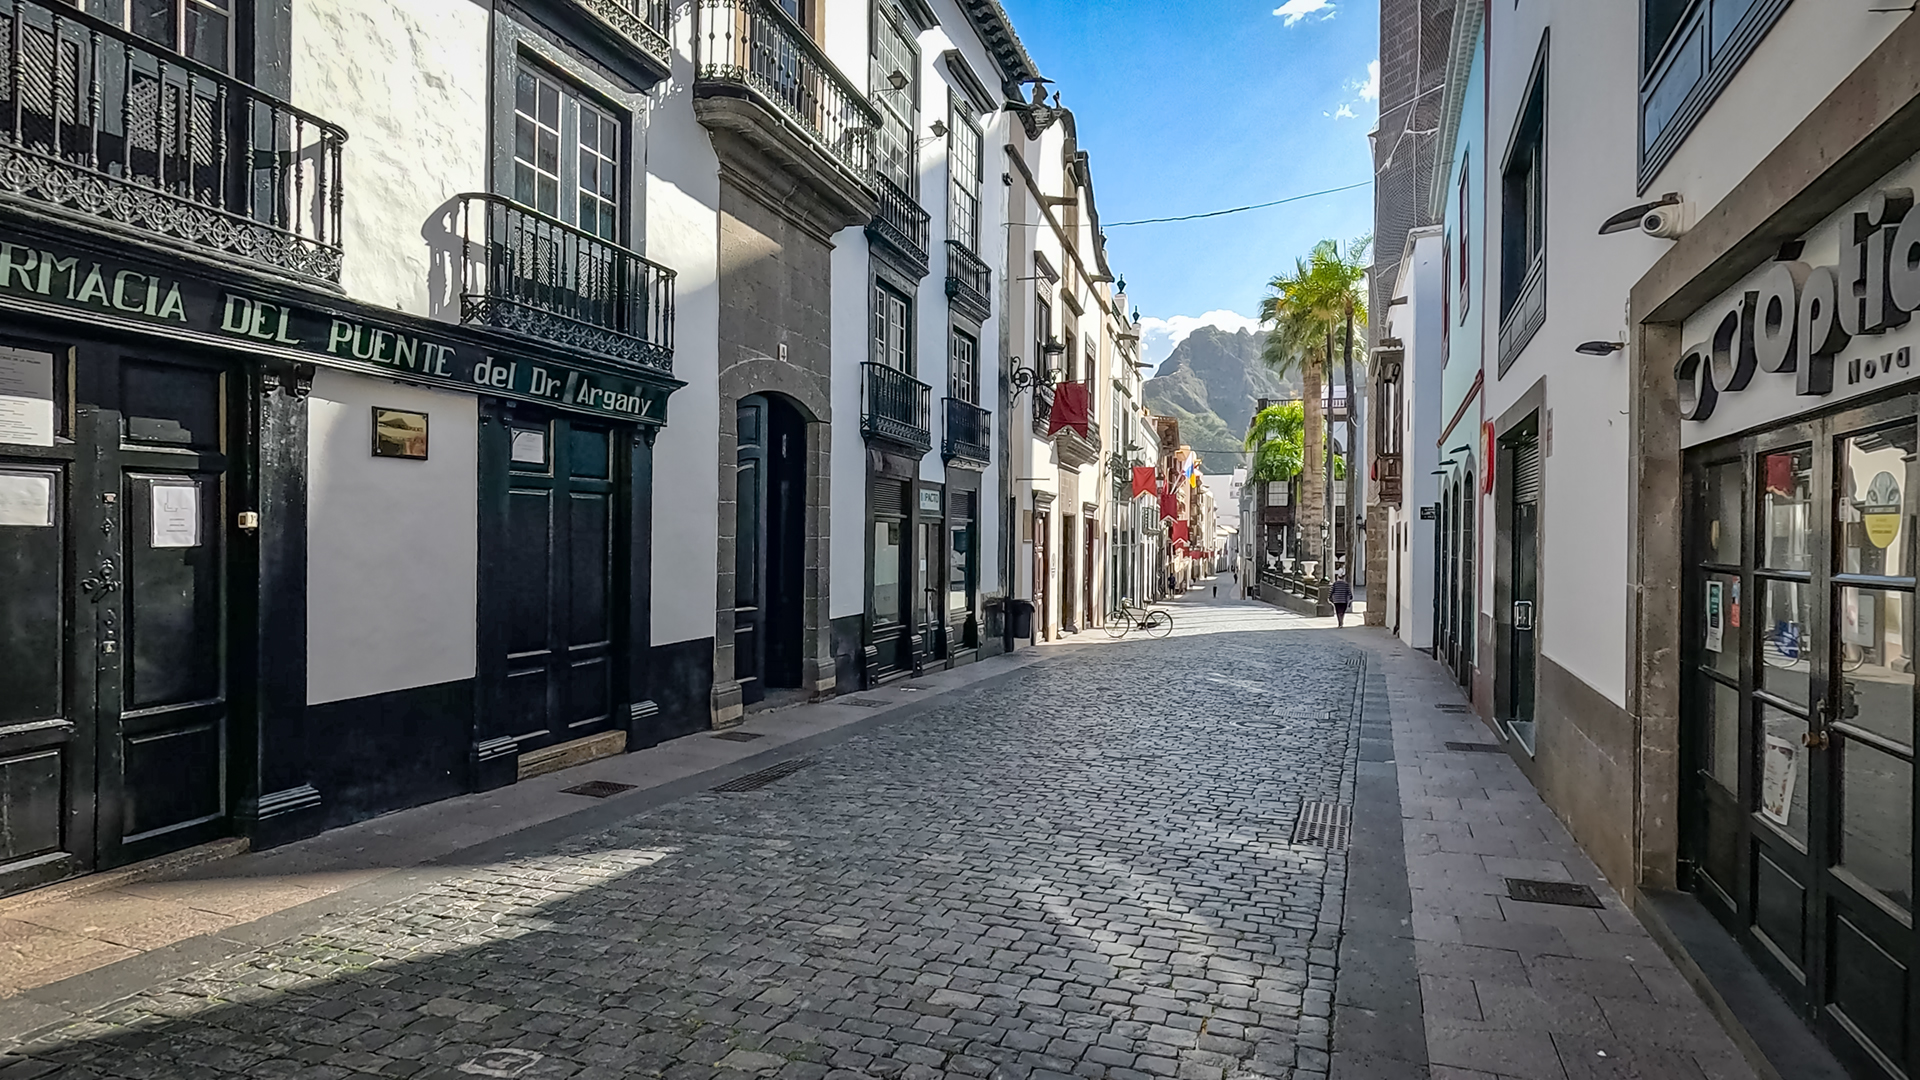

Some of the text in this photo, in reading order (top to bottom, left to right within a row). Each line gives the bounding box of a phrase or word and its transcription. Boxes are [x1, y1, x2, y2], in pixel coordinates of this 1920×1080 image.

[221, 294, 299, 344] DEL
[327, 318, 456, 377] PUENTE
[473, 356, 517, 390] del
[529, 367, 561, 398] Dr.
[576, 379, 652, 416] Argany
